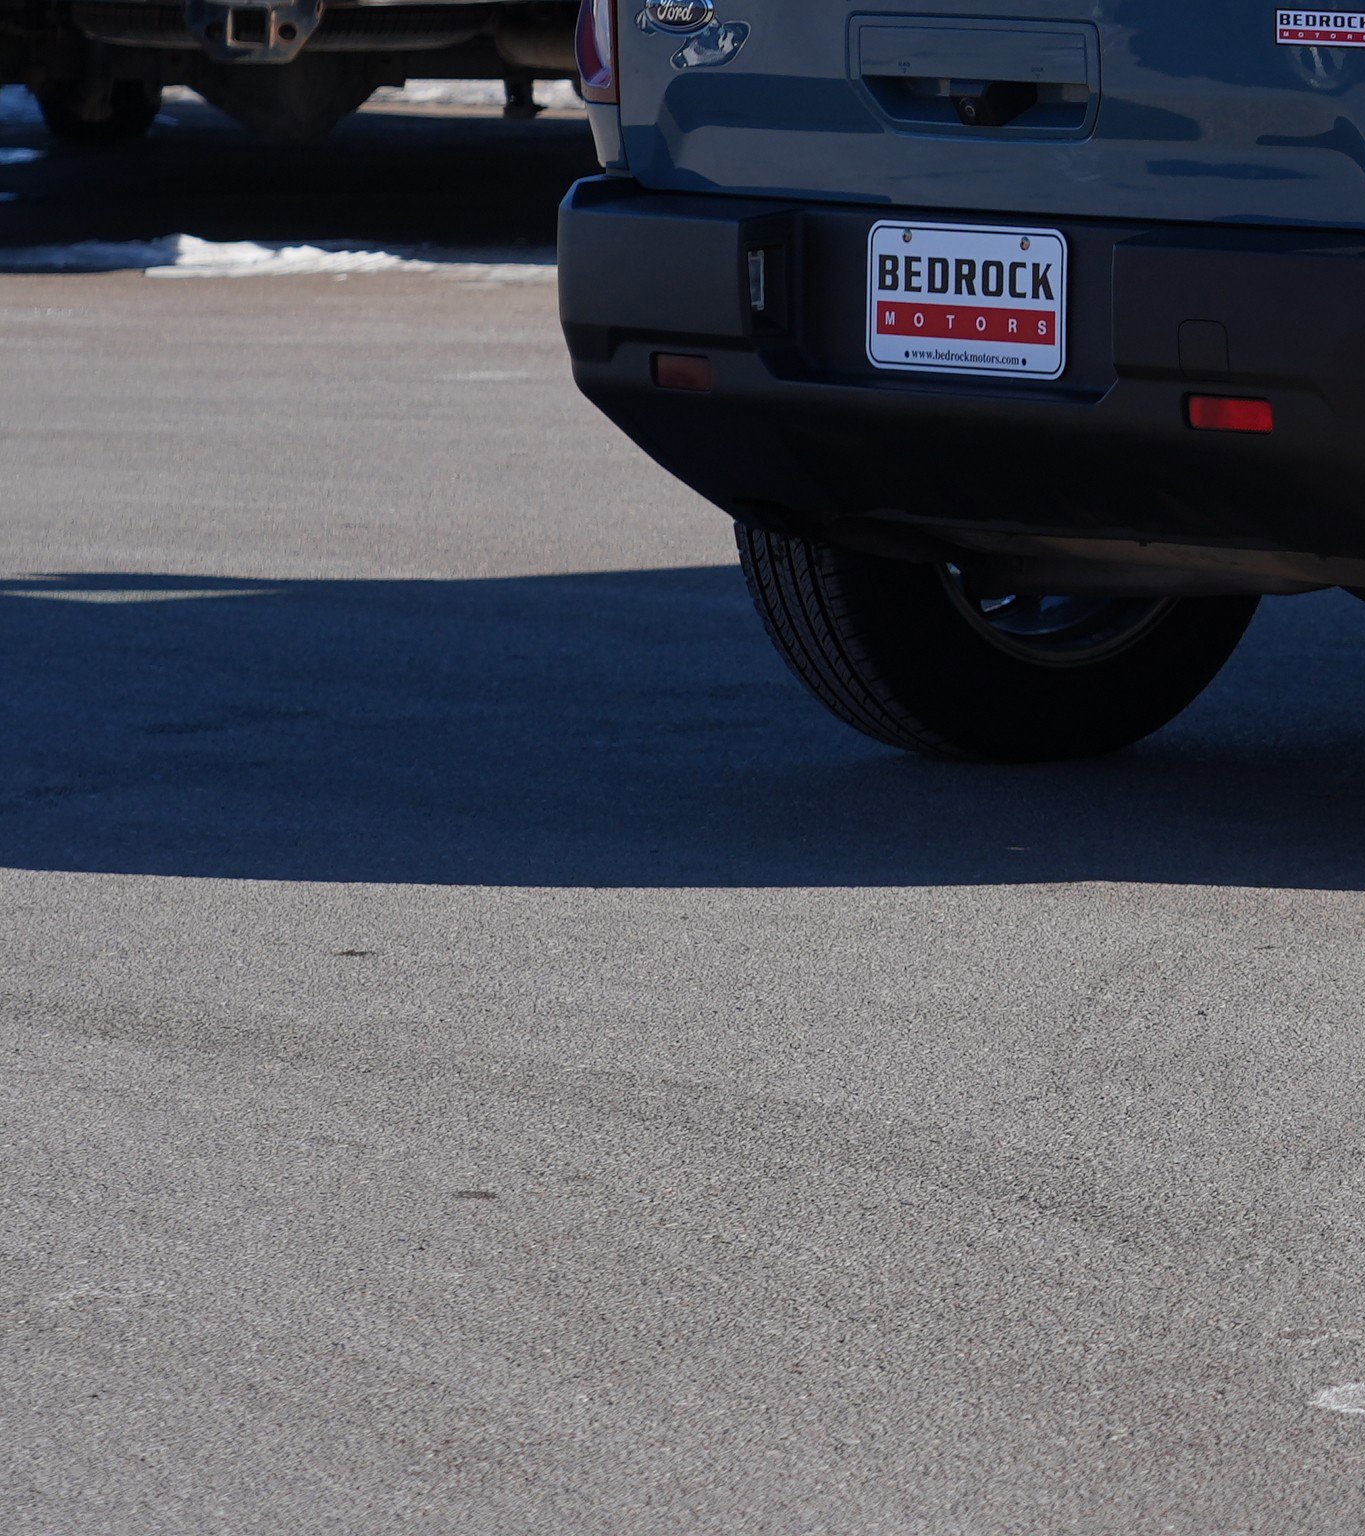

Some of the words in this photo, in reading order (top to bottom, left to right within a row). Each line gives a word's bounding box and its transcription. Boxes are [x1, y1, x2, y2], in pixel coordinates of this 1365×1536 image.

[878, 254, 1055, 301] BEDROCK
[885, 310, 1047, 336] MOTORS
[911, 348, 1020, 366] www.bedrockmotors.com
